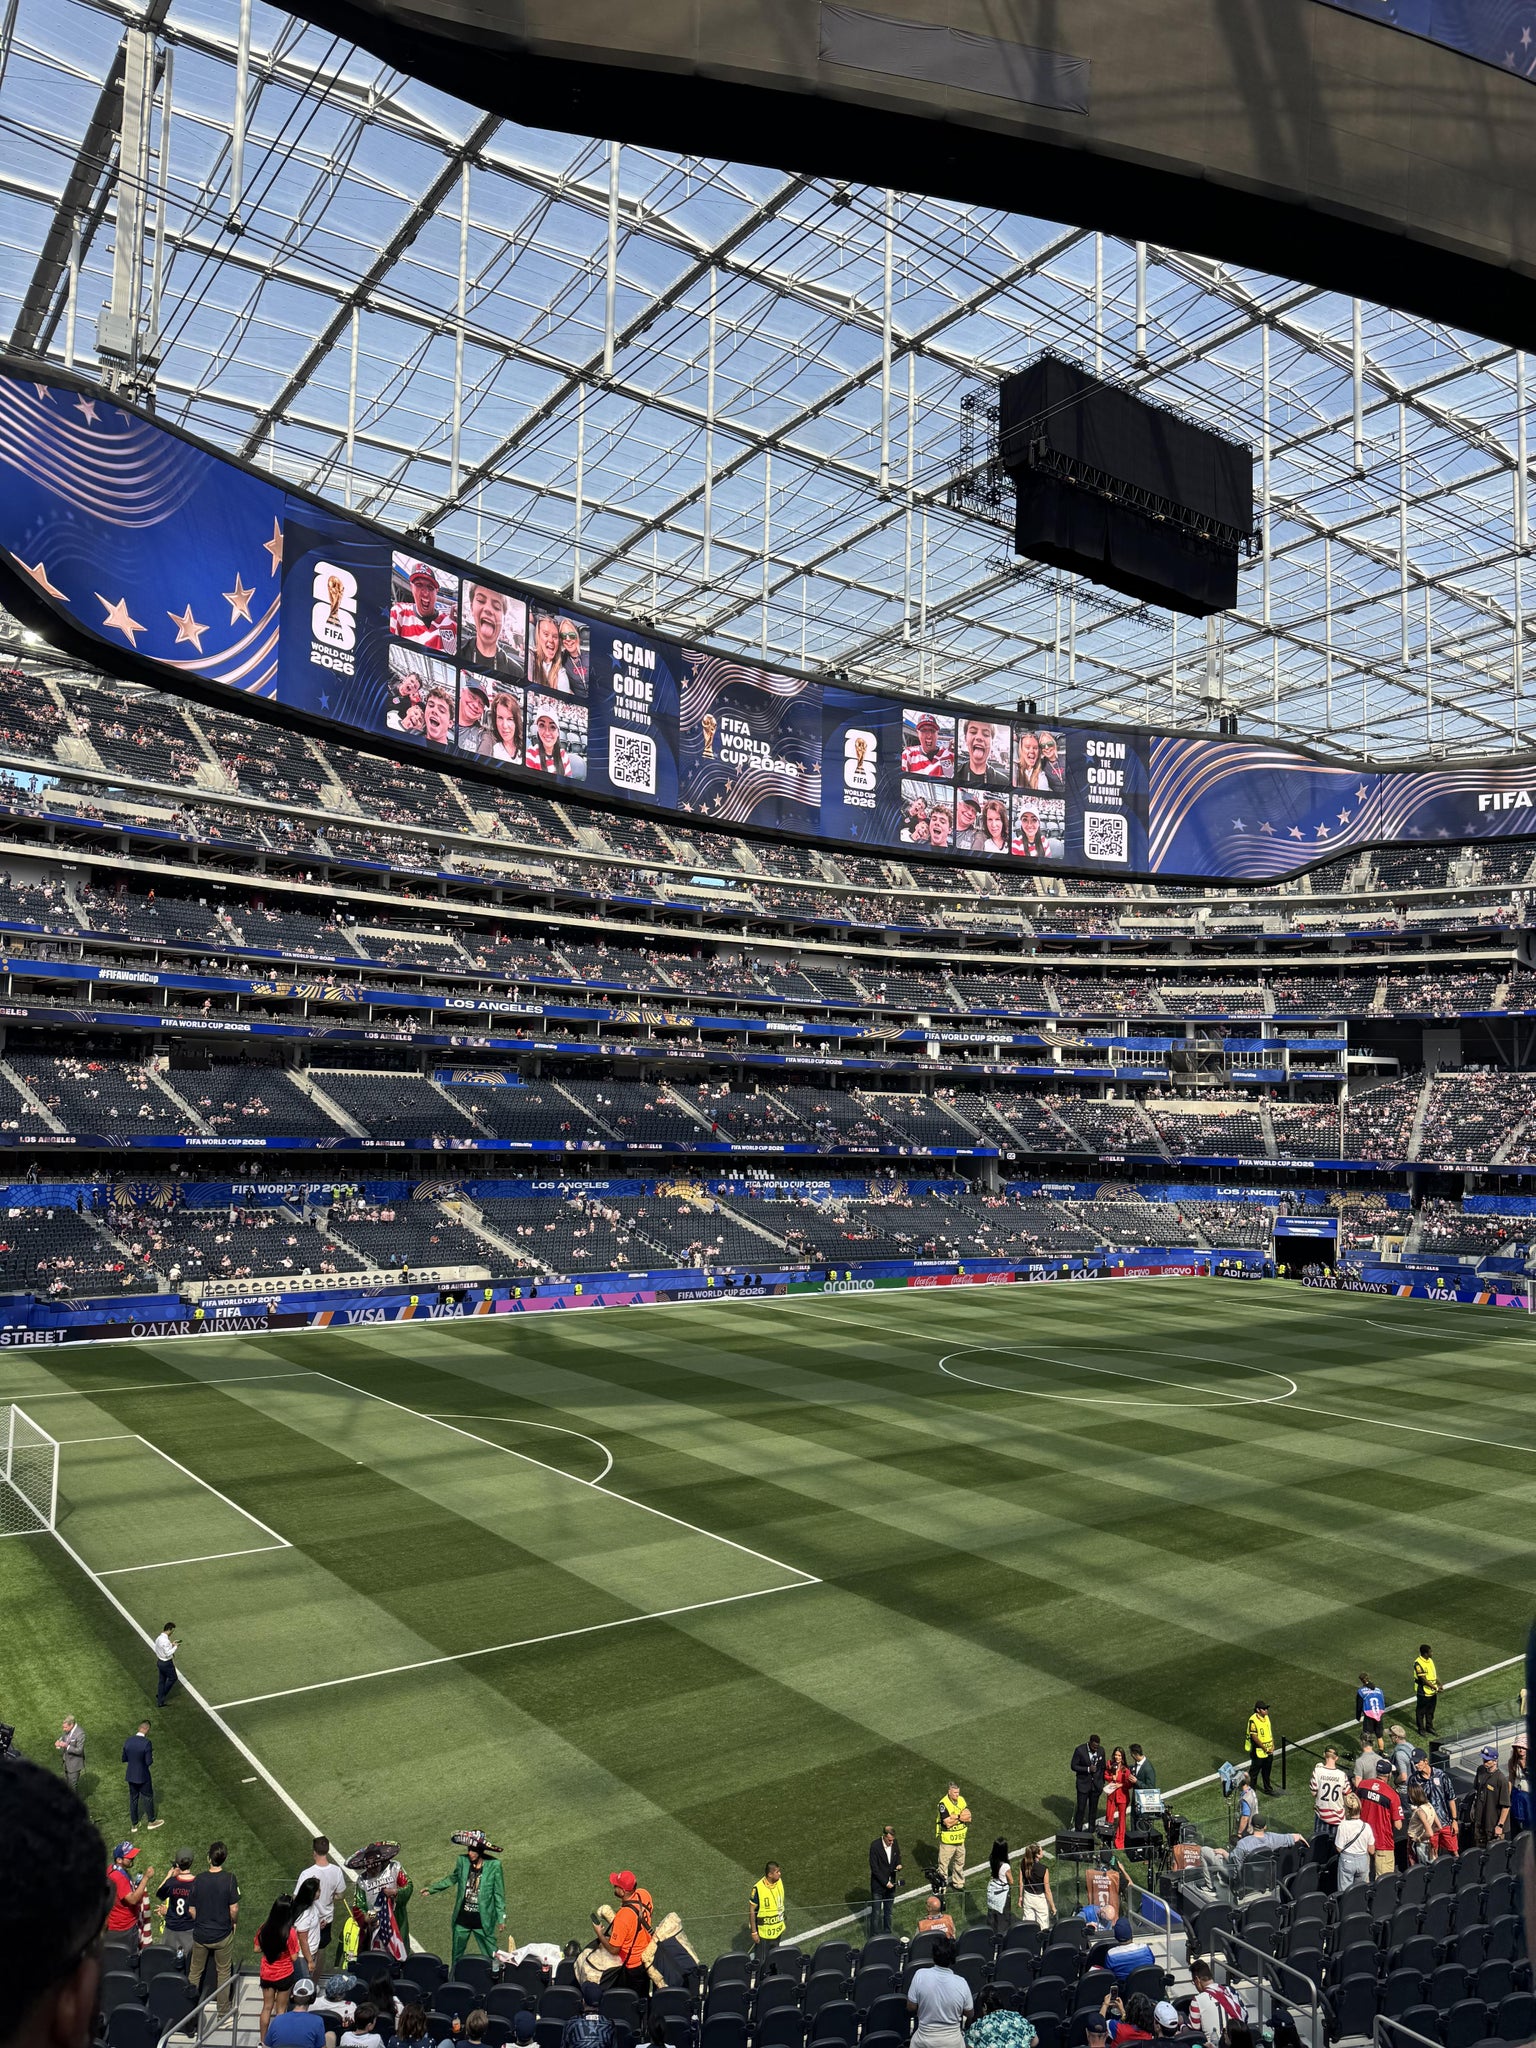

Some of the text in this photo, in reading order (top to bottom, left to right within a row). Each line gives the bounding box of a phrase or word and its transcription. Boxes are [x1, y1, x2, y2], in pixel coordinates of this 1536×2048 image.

[324, 628, 344, 641] FIFA
[311, 641, 355, 662] WORLD CUP
[613, 640, 656, 670] SCAN
[310, 651, 355, 676] 2026
[628, 666, 639, 678] THE
[613, 673, 653, 702] CODE
[616, 696, 649, 714] TO SUBMIT
[614, 706, 651, 726] YOUR PHOTO
[721, 717, 750, 736] FIFA
[720, 733, 770, 755] WORLD
[1086, 740, 1125, 759] SCAN
[720, 749, 798, 777] CUP 2026
[1101, 759, 1111, 768] THE
[853, 776, 867, 784] FIFA
[1087, 768, 1124, 786] CODE
[844, 789, 864, 797] WORLD
[1090, 786, 1120, 796] TO SUBMIT
[843, 796, 876, 808] 2026
[1088, 795, 1122, 806] YOUR PHOTO
[1478, 791, 1533, 811] FIFA
[99, 969, 158, 984] #FIFAWorldCup
[445, 999, 543, 1014] LOS ANGELES
[178, 1020, 207, 1028] WORLD
[224, 1023, 251, 1031] 2026
[380, 1033, 412, 1041] ANGELES
[924, 1032, 940, 1040] FIFA
[232, 1185, 256, 1194] FIFA
[1161, 1266, 1191, 1274] Lenovo
[1223, 1269, 1240, 1278] ADI
[824, 1279, 874, 1293] aramco
[1302, 1277, 1388, 1294] QATAR AIRWAYS
[678, 1291, 695, 1299] FIFA
[695, 1290, 722, 1298] WORLD
[739, 1287, 764, 1295] 2026
[1427, 1287, 1458, 1301] VISA
[216, 1307, 241, 1318] FIFA
[344, 1308, 385, 1322] VISA
[426, 1303, 464, 1318] VISA
[131, 1316, 268, 1337] QATAR AIRWAYS
[0, 1330, 67, 1344] STREET
[1320, 1783, 1341, 1802] 26
[1368, 1791, 1380, 1801] USA
[176, 1898, 185, 1915] 8
